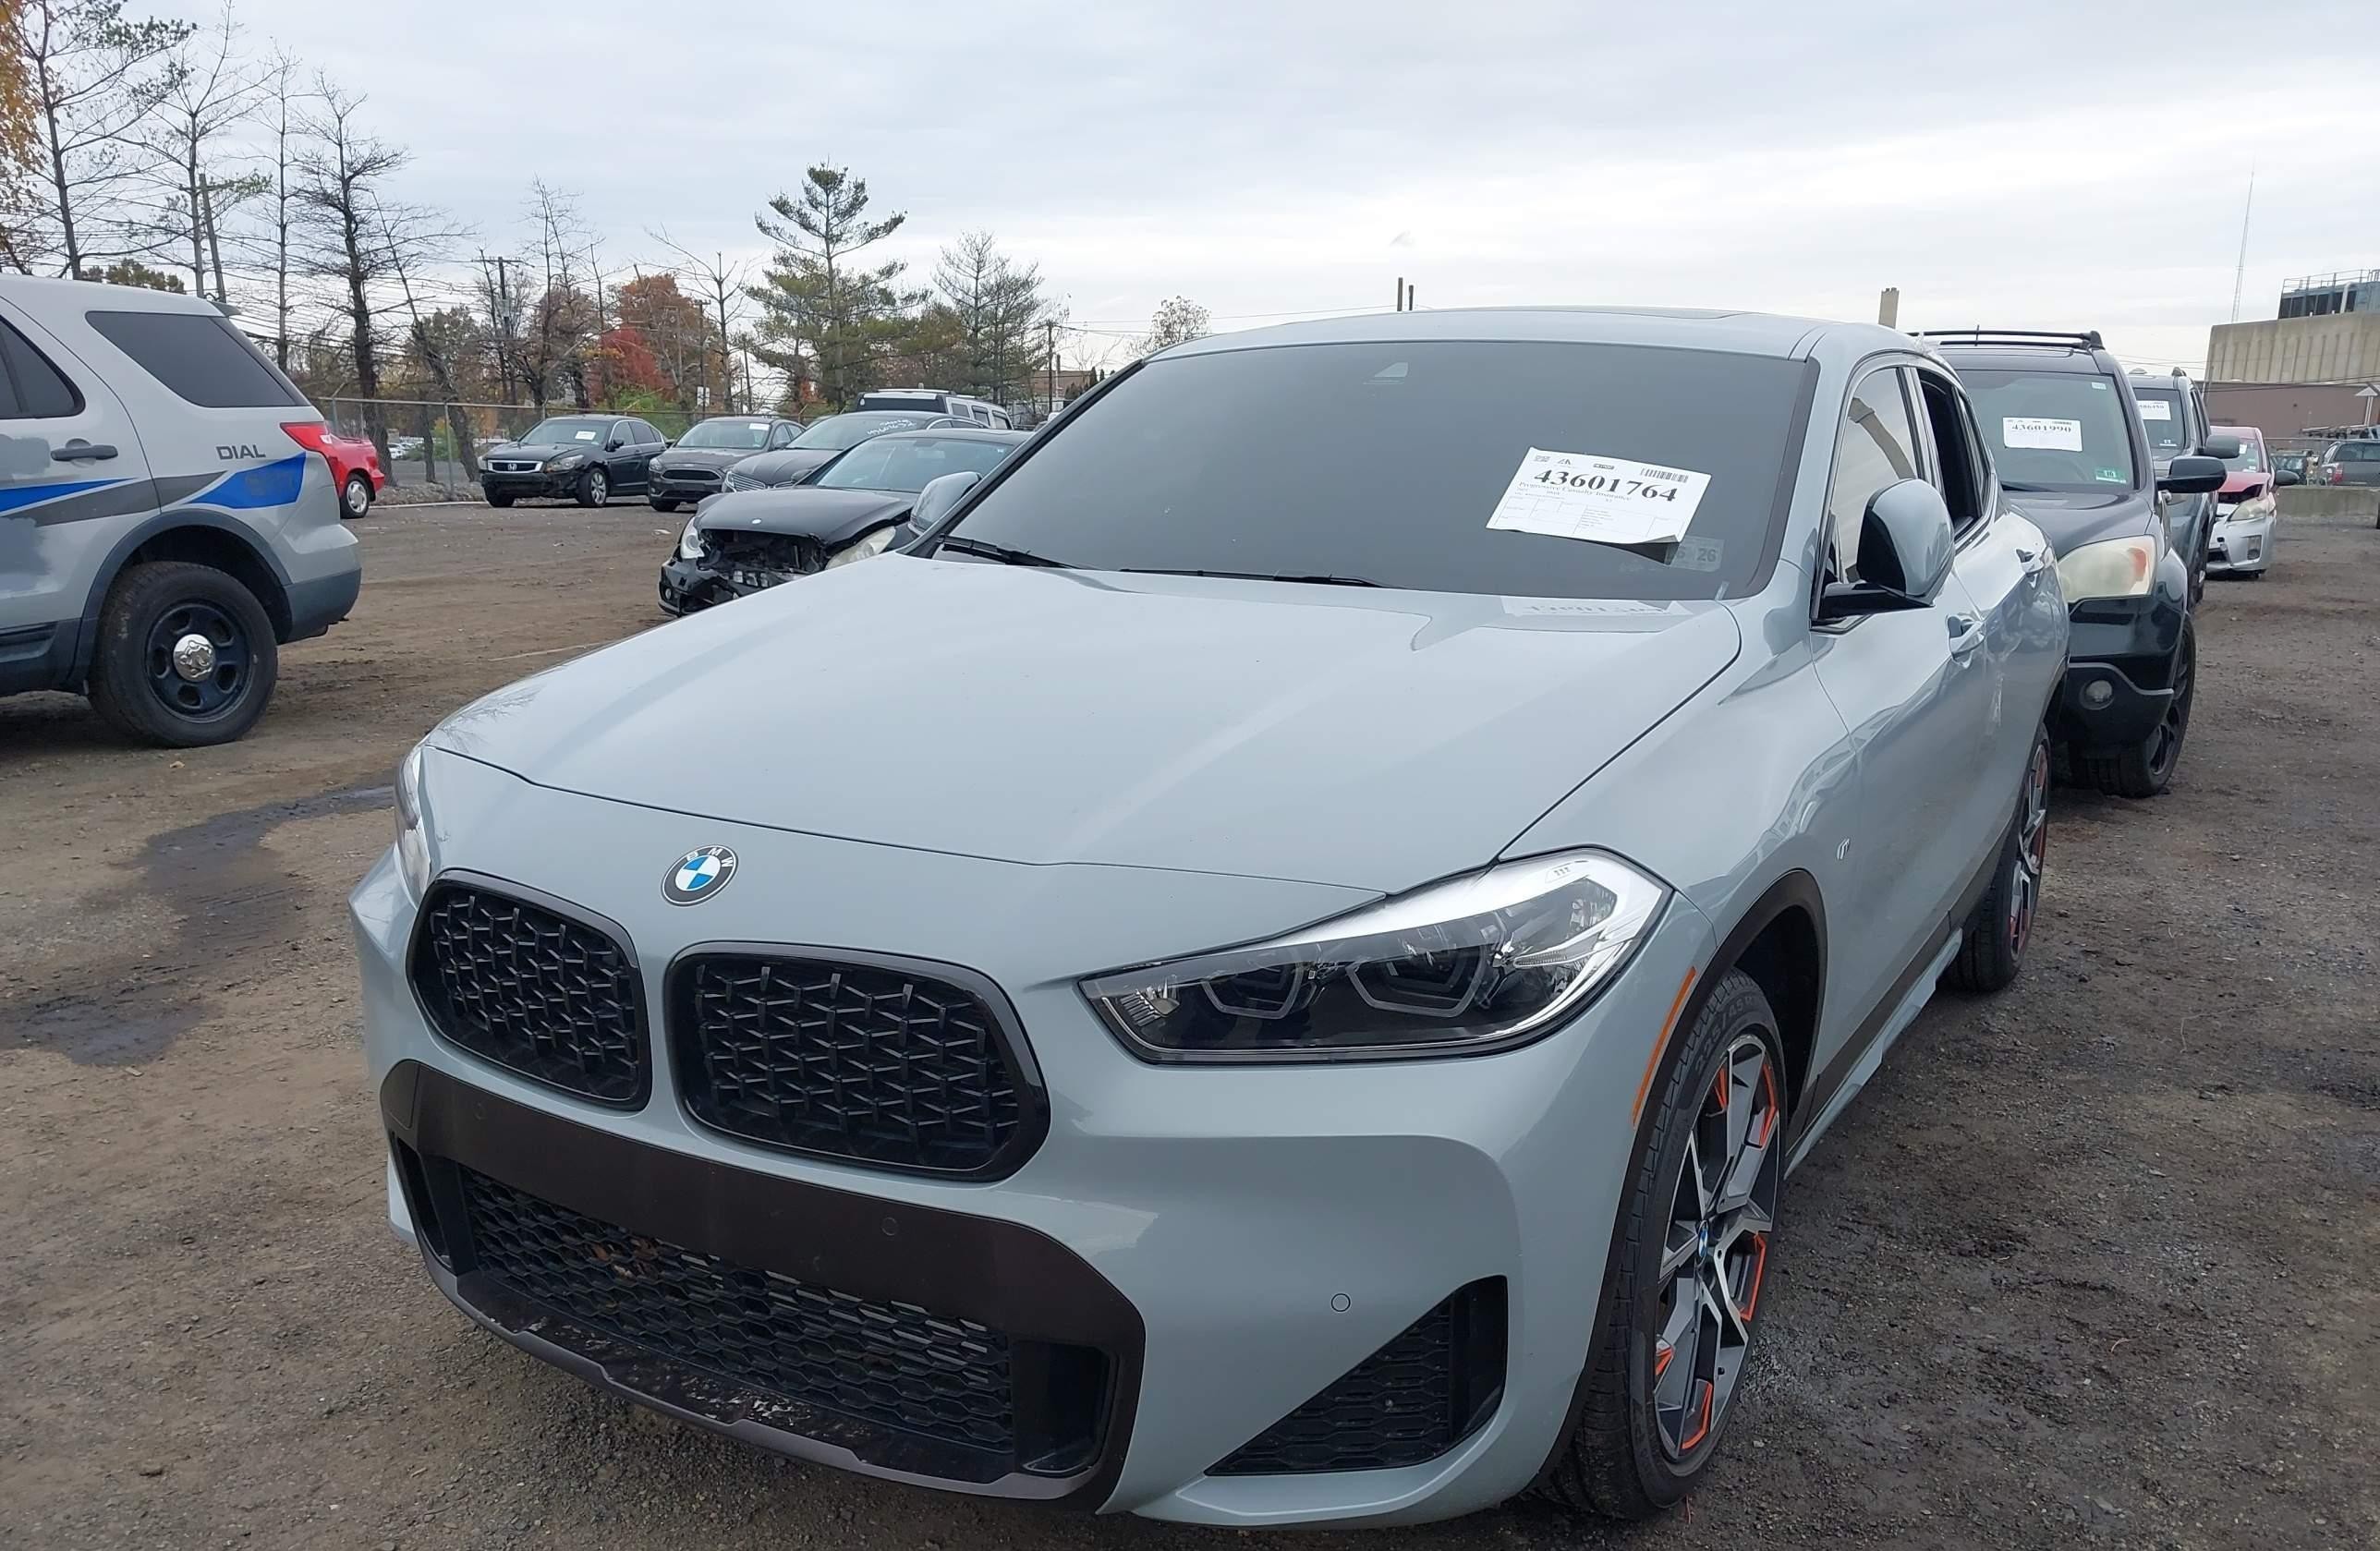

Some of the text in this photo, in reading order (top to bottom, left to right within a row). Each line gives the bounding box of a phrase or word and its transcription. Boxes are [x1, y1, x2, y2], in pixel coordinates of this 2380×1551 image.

[216, 444, 266, 460] DIAL
[1534, 469, 1677, 502] 43601764
[1696, 548, 1717, 563] 26
[686, 847, 734, 867] BMW
